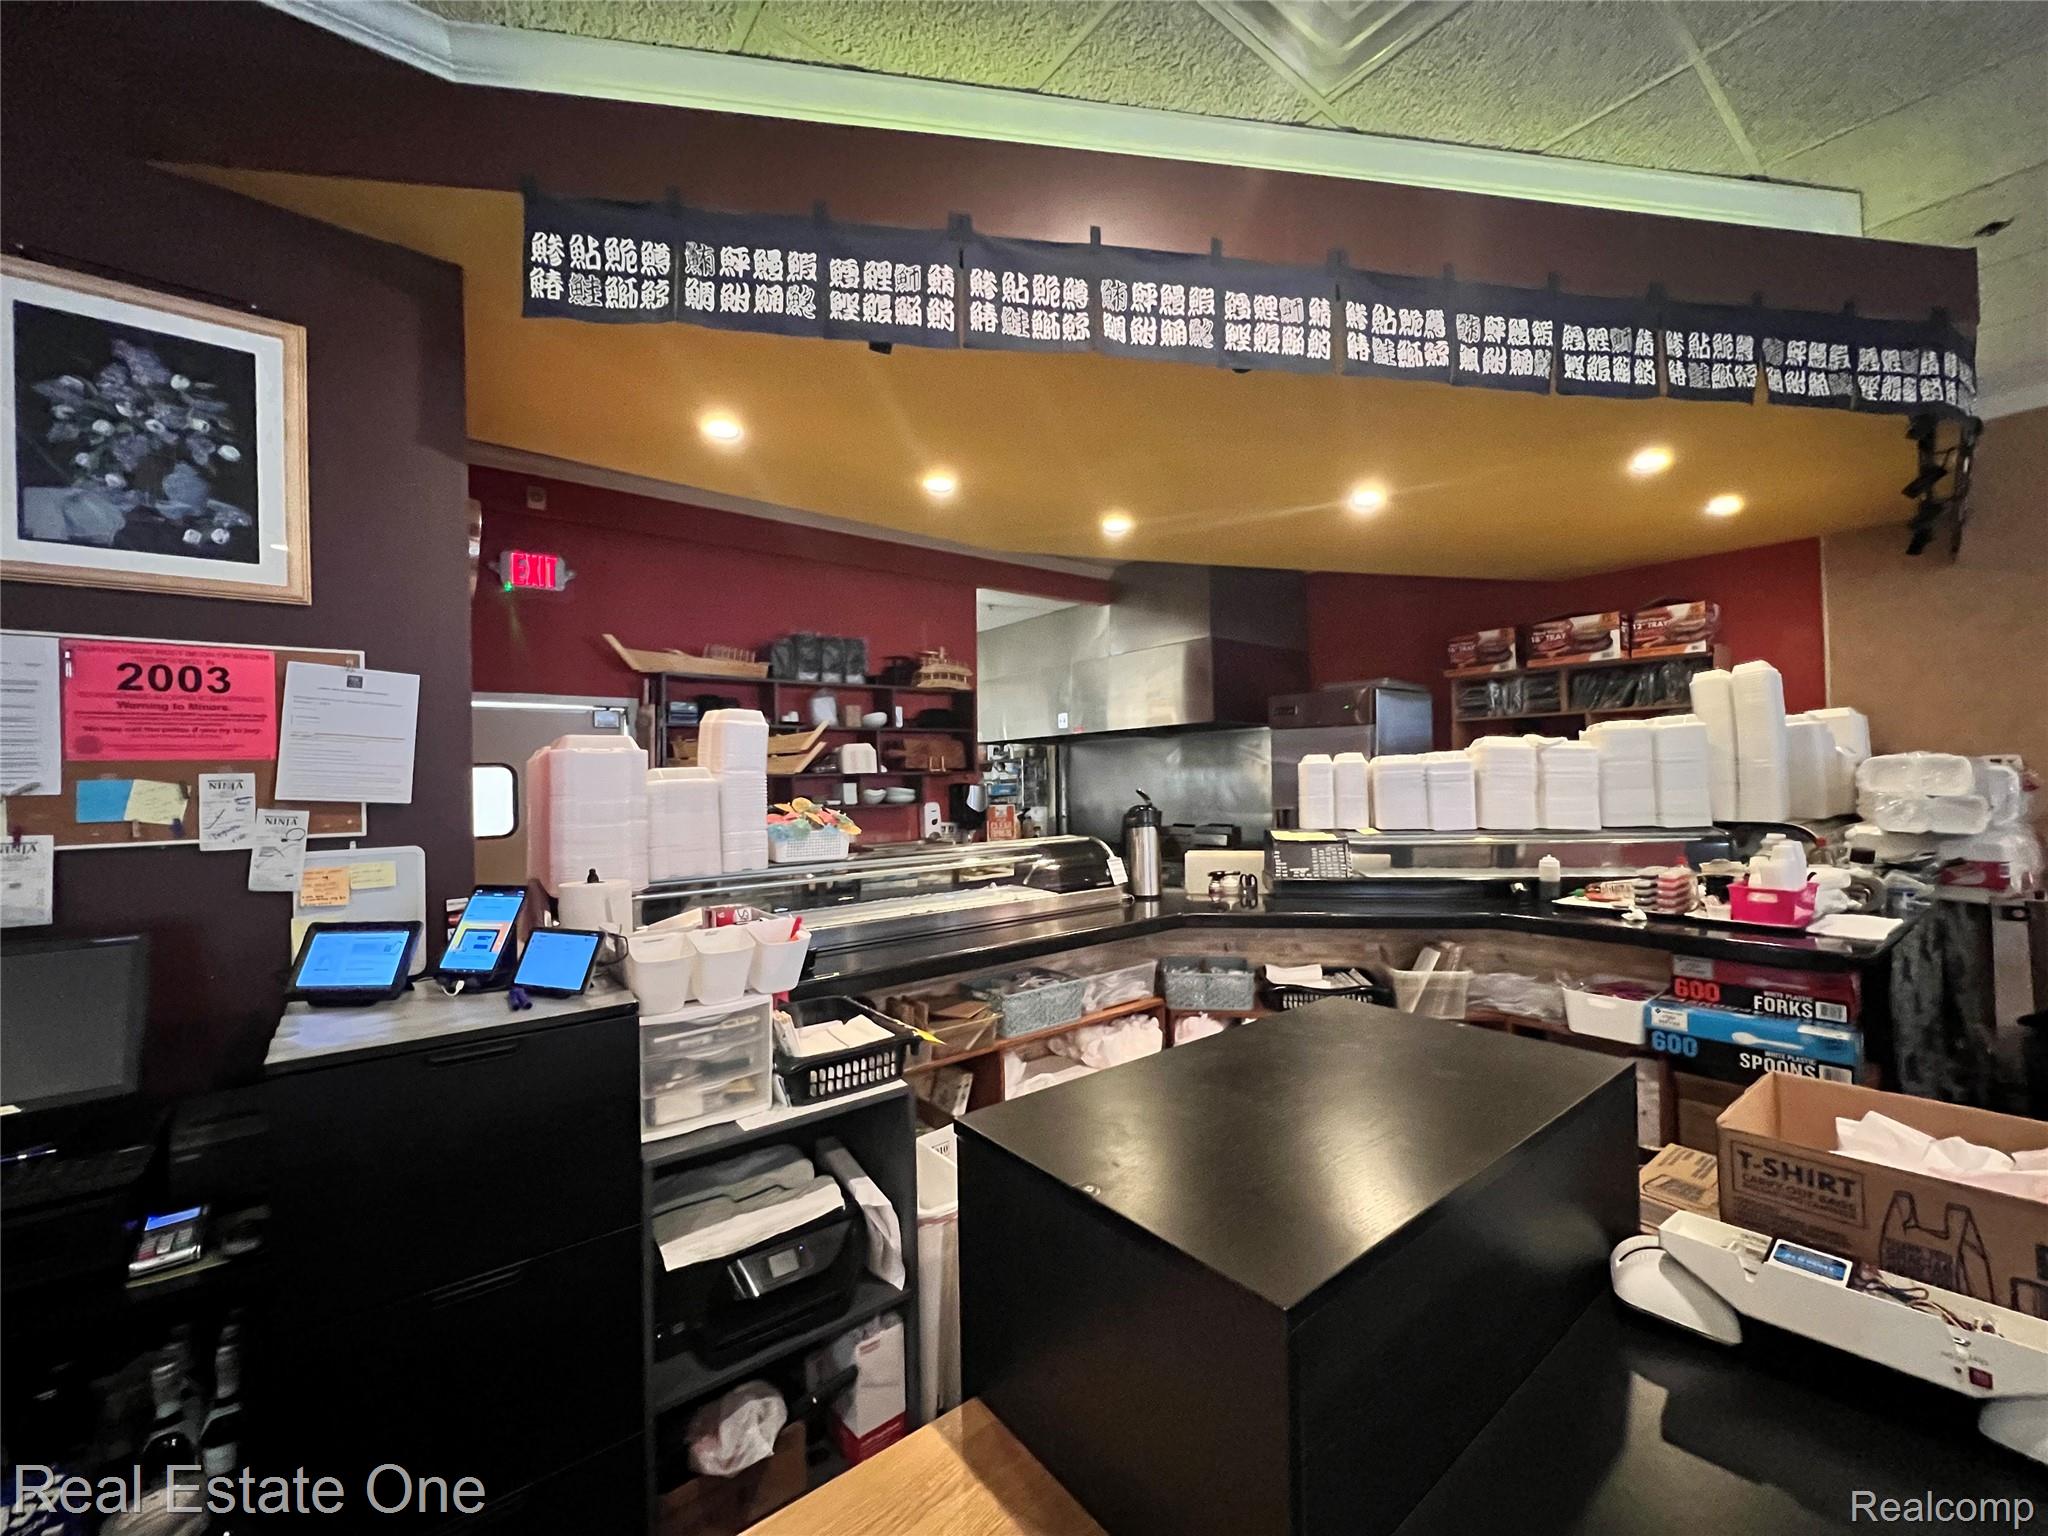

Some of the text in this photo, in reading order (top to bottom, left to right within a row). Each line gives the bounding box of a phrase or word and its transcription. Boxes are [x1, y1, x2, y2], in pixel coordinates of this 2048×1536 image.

[512, 552, 557, 590] EXIT
[116, 662, 231, 694] 2003
[208, 781, 244, 791] NINJA
[264, 816, 298, 826] NINJA
[1674, 978, 1720, 1002] 600
[1763, 990, 1814, 1002] WHITE PLASTIC
[1753, 995, 1813, 1018] FORKS
[1651, 1030, 1698, 1057] 600
[1764, 1050, 1816, 1064] WHITE PLASTIC
[1736, 1148, 1856, 1197] T-SHIRT
